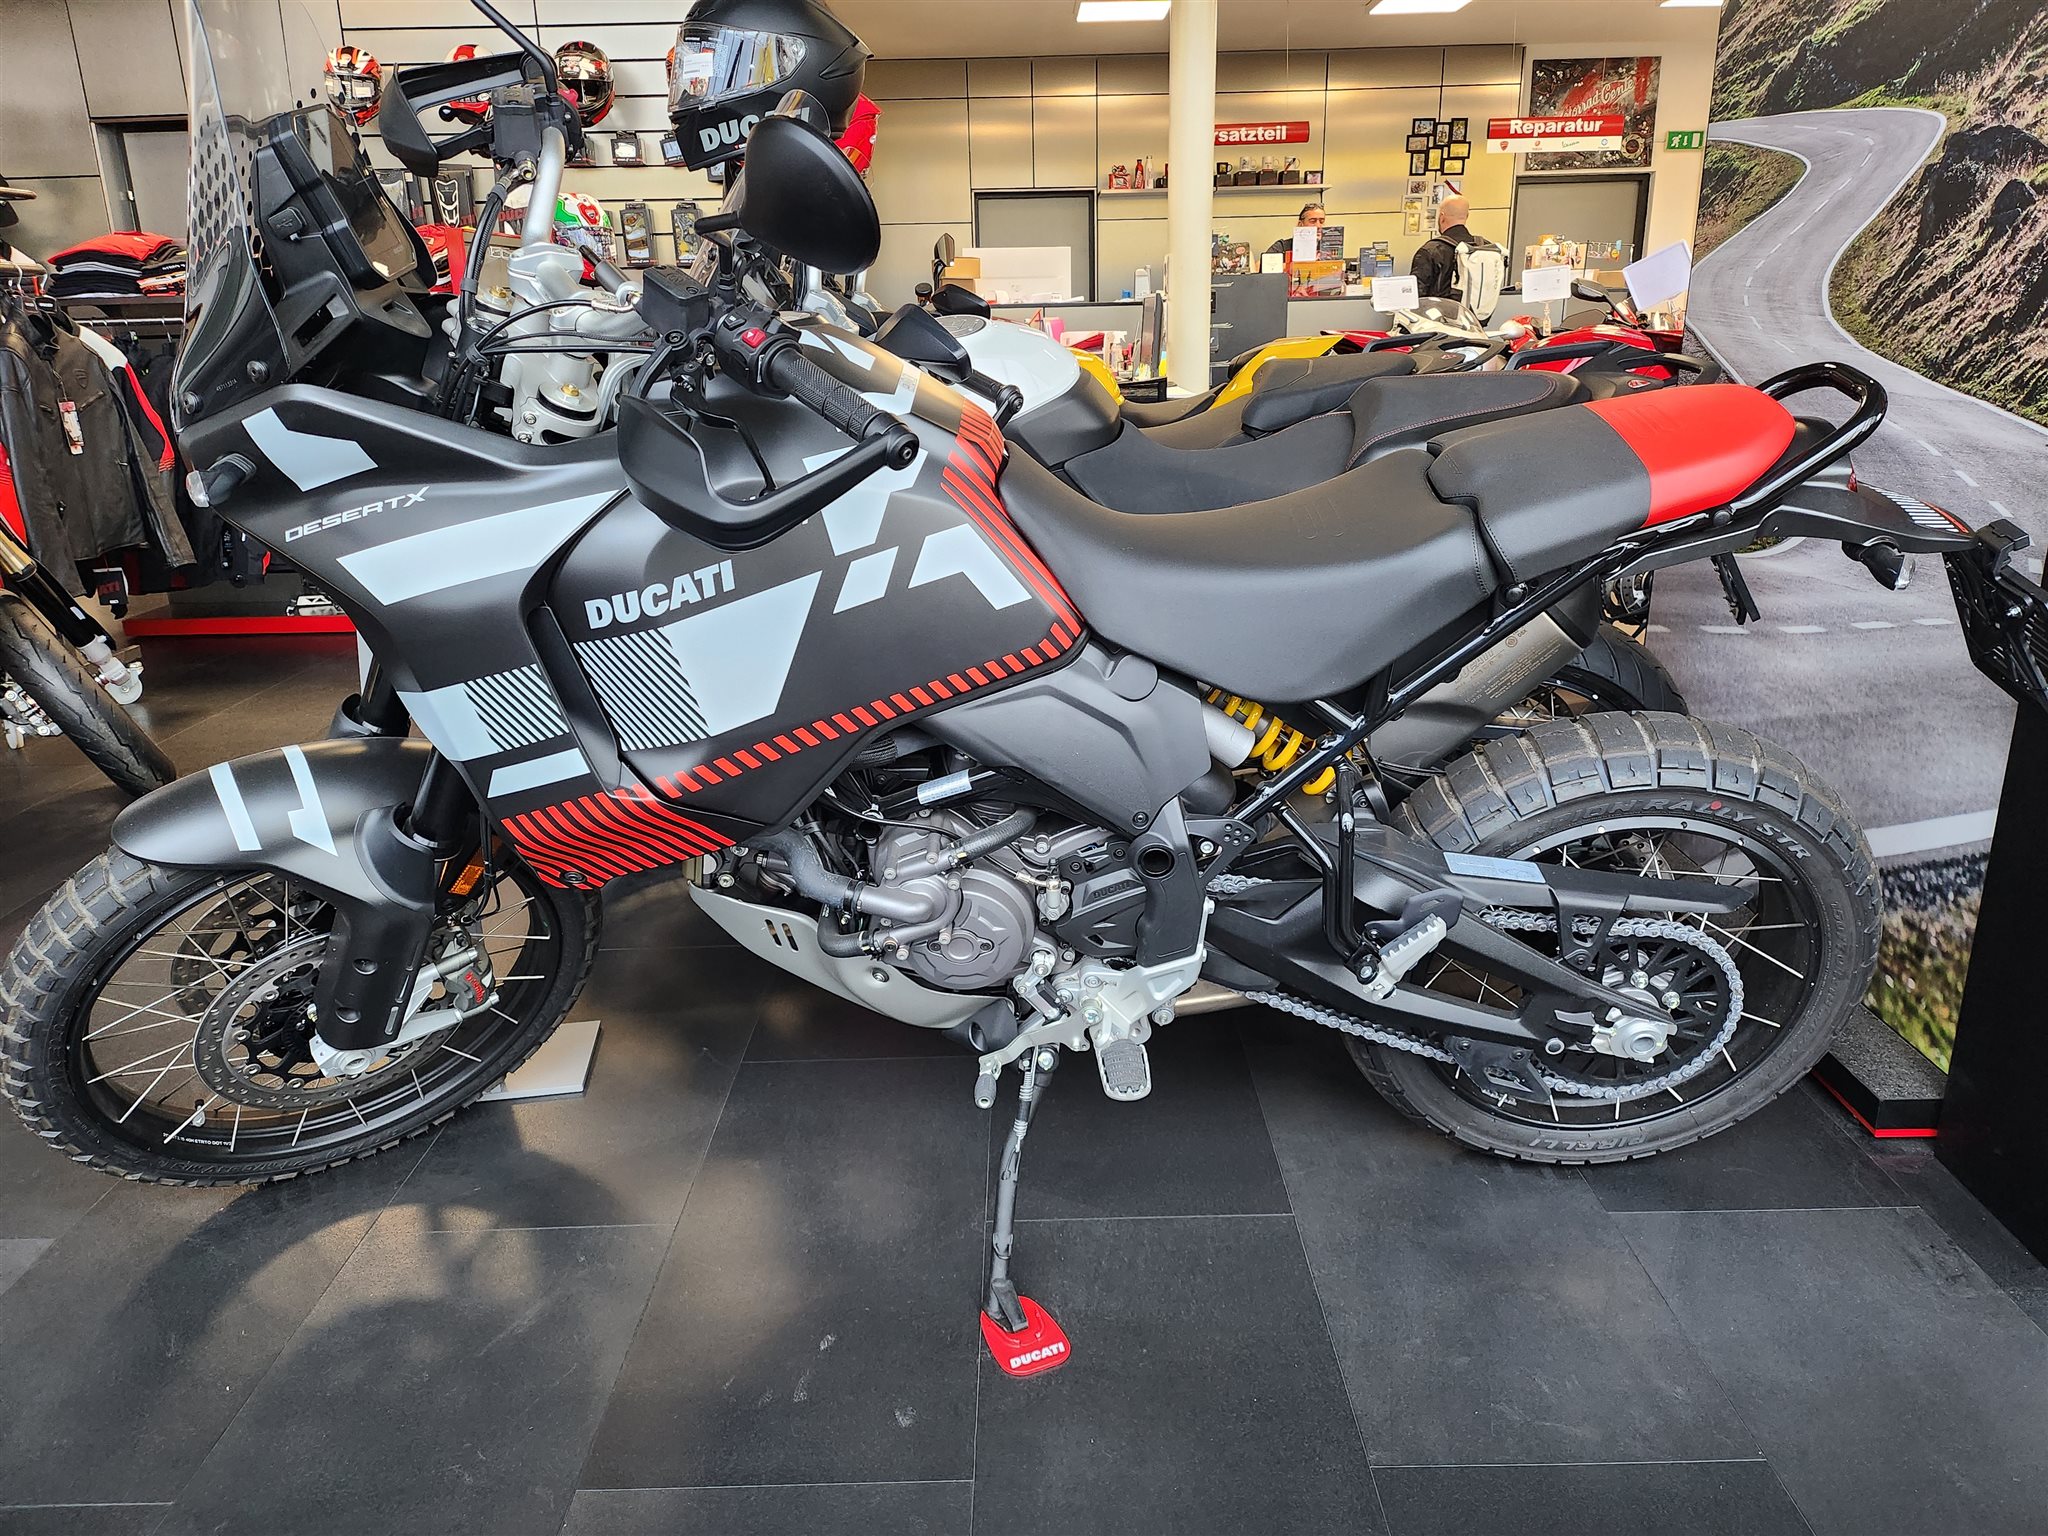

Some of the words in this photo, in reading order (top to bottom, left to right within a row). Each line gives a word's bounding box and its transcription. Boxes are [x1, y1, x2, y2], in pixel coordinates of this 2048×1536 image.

[1509, 118, 1603, 136] Reparatur
[584, 558, 736, 630] DUCATI
[1643, 798, 1756, 823] RALLY
[1755, 822, 1813, 860] STR
[1093, 882, 1130, 899] DUCATI
[1010, 1342, 1066, 1369] DUCATI
